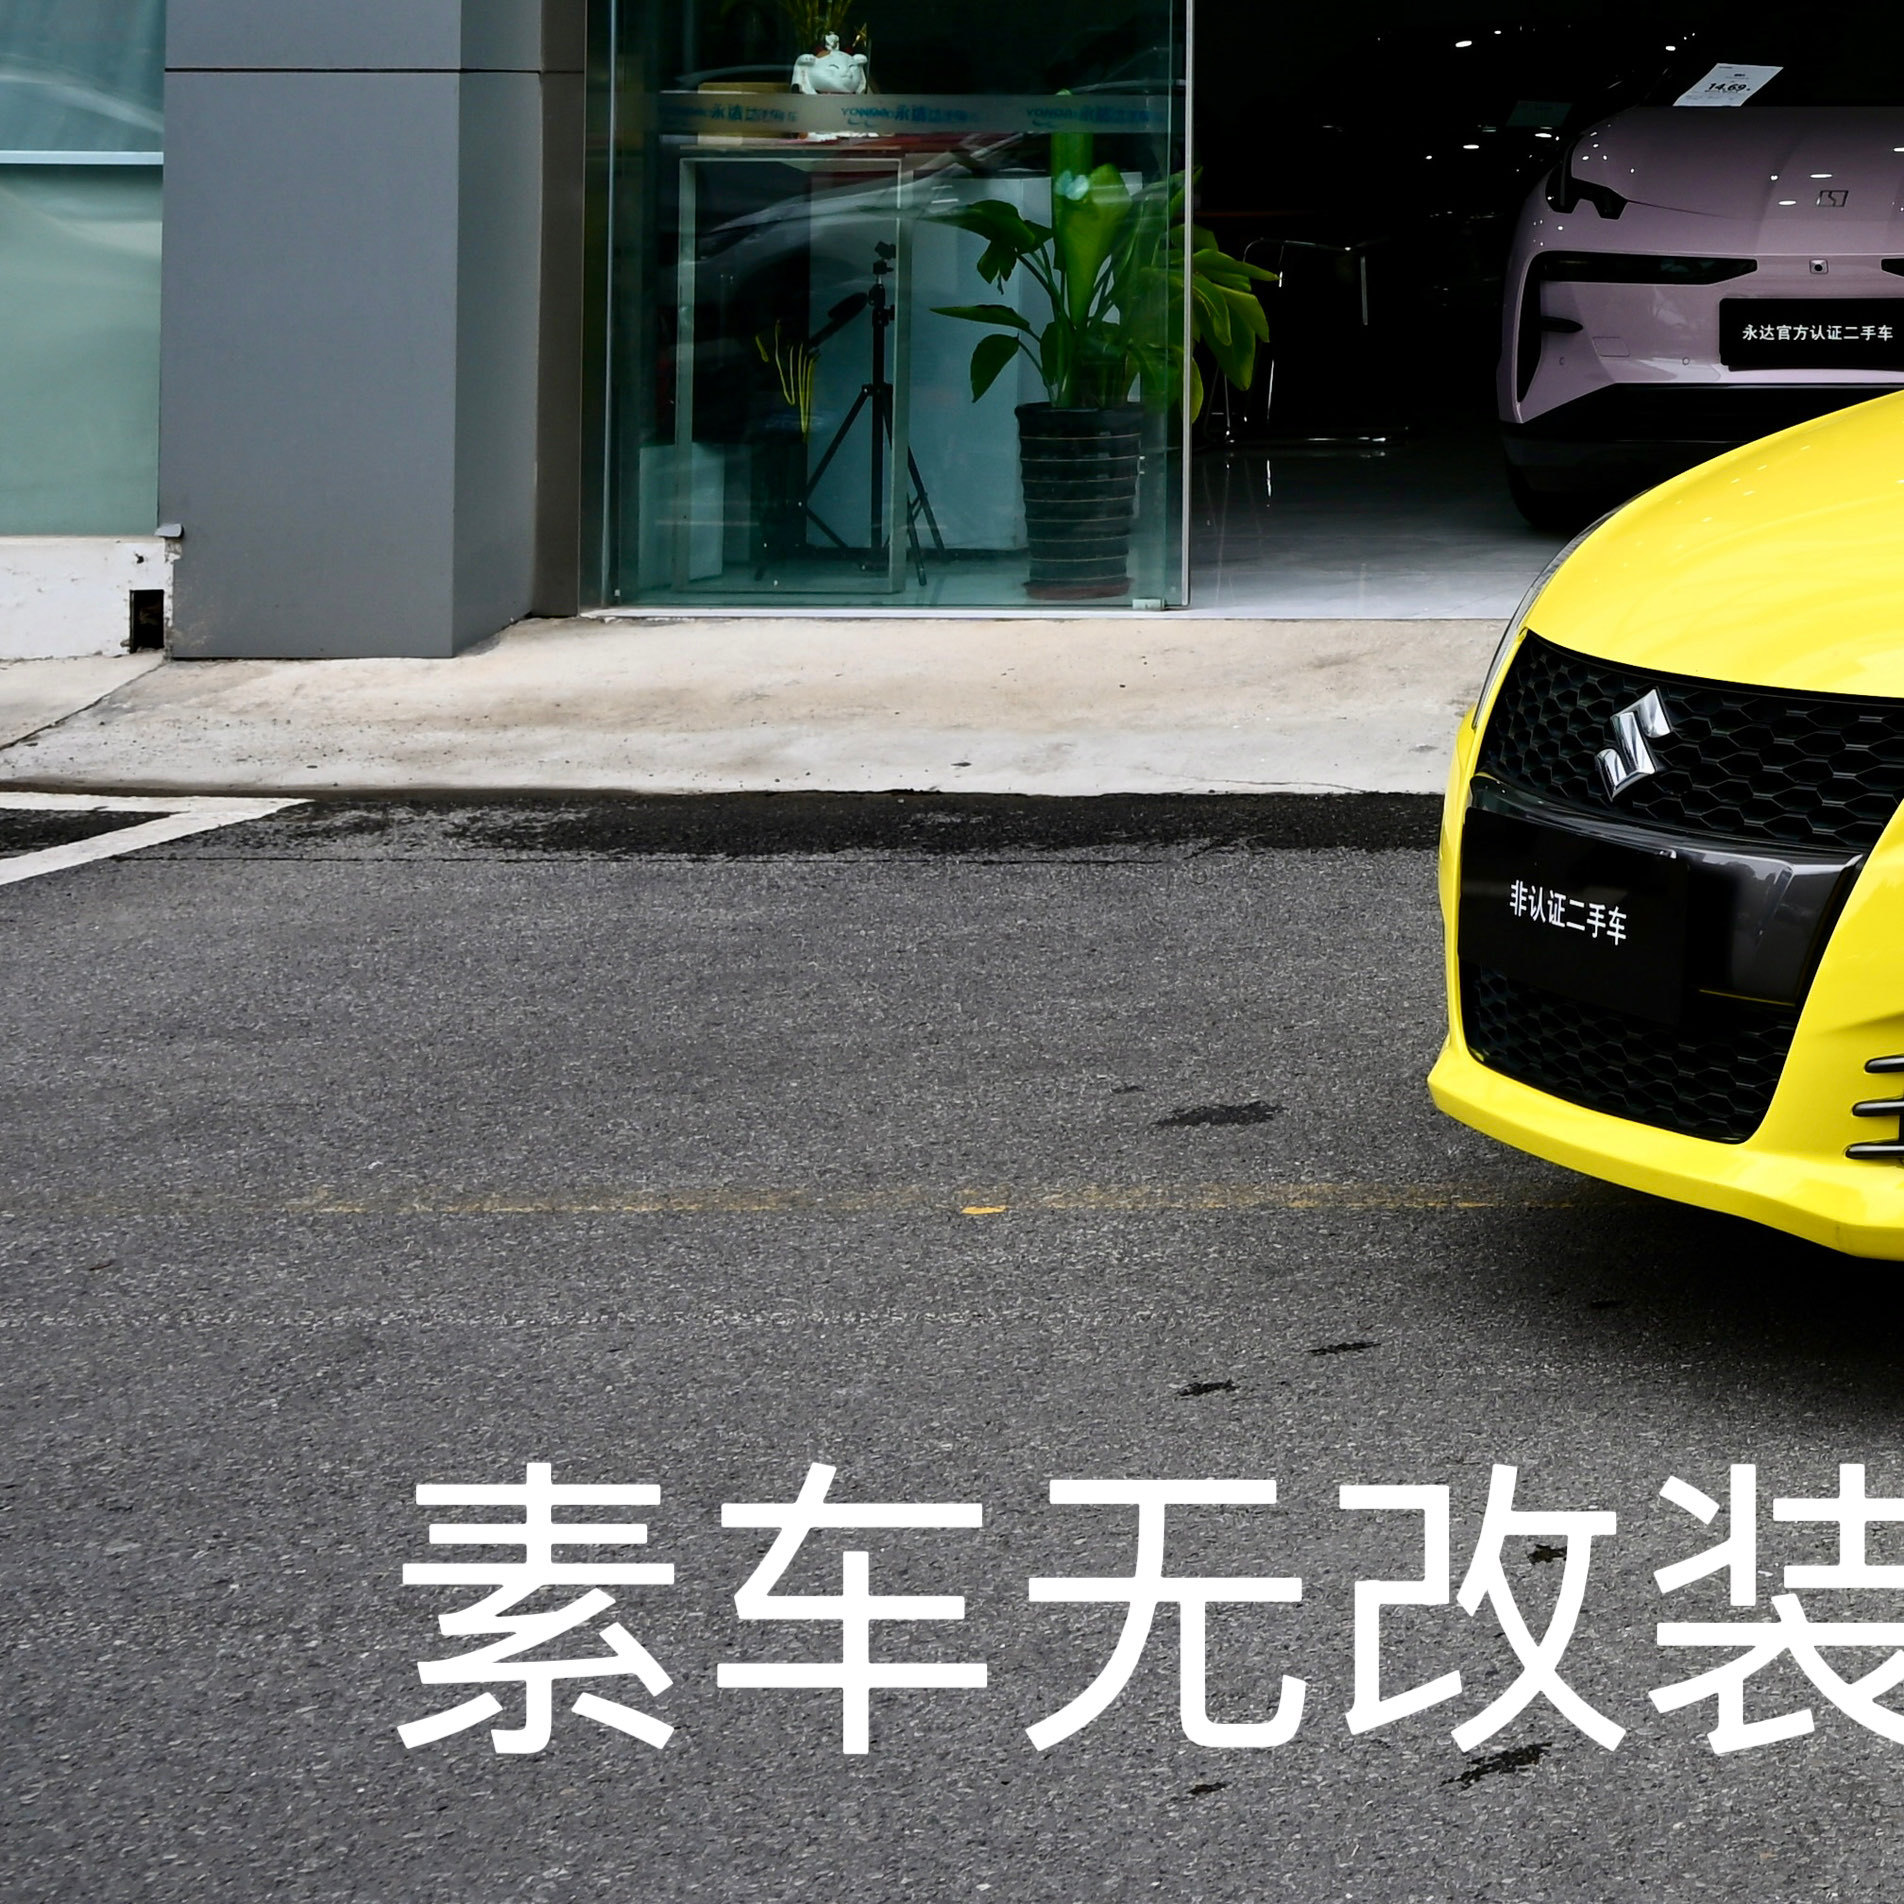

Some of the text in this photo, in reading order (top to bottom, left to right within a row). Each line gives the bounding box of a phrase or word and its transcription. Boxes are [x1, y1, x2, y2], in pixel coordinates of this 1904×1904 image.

[1742, 323, 1894, 342] 永达官方认证二手车
[1509, 879, 1628, 946] 非认证二手车
